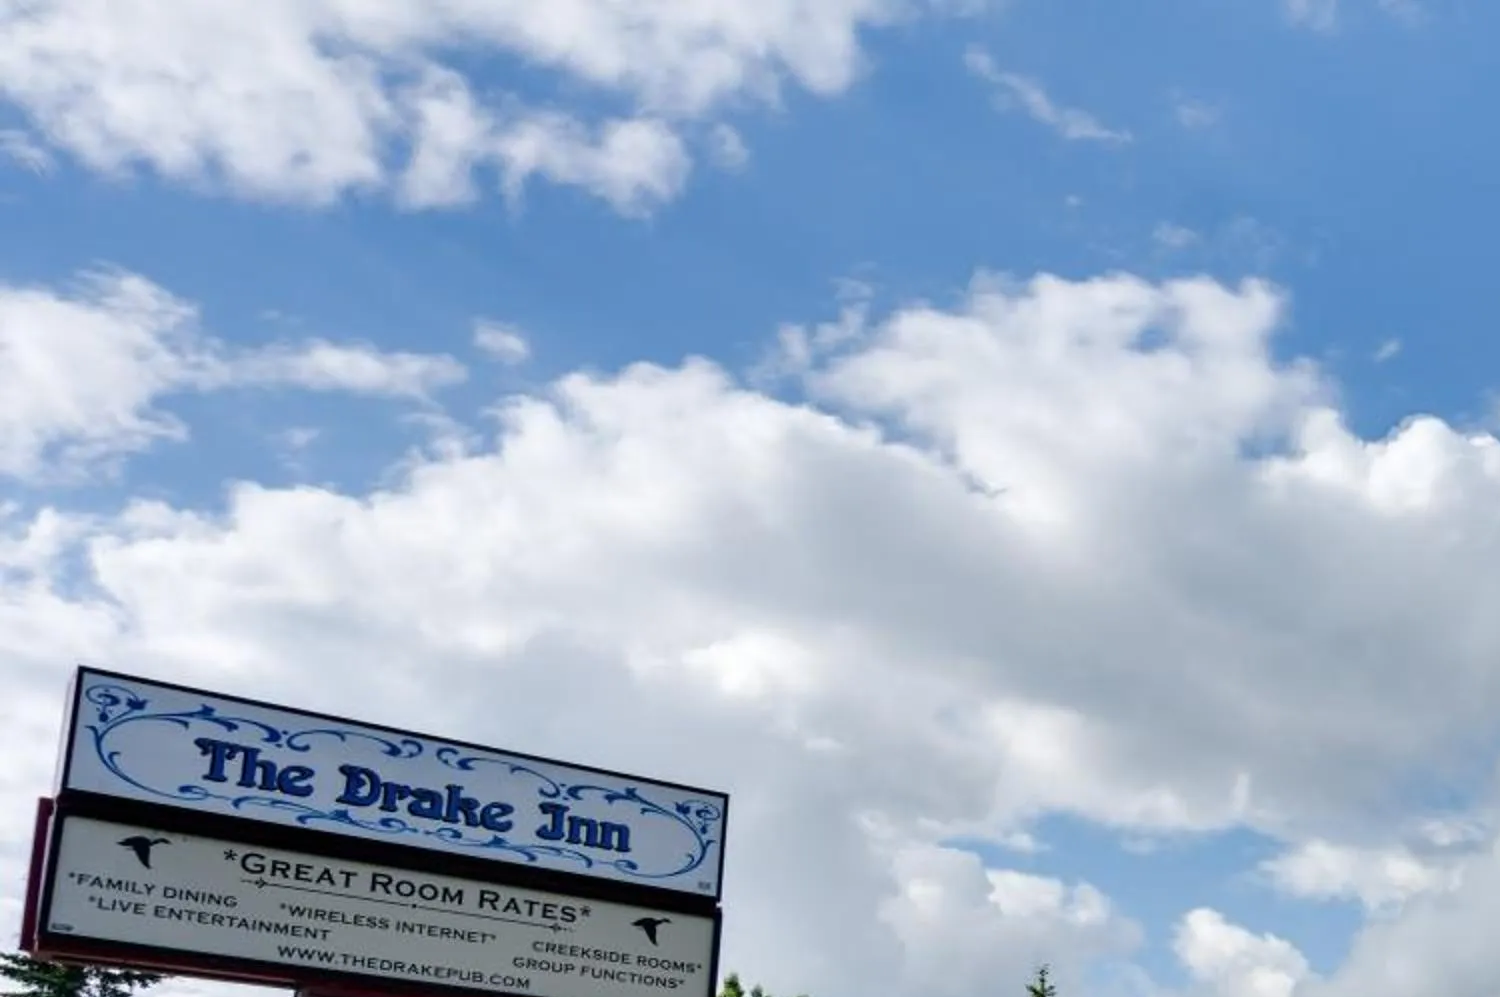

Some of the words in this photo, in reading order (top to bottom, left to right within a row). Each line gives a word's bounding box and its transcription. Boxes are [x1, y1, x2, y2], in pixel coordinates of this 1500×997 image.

[194, 737, 315, 797] The
[336, 764, 515, 833] Drake
[536, 803, 632, 853] Inn
[163, 886, 238, 908] DINING
[370, 873, 464, 905] ROOM
[154, 905, 332, 941] ENTERTAINMENT
[277, 945, 531, 989] WWW.THEDRAKEPUB.COM
[512, 956, 575, 975] GROUP
[532, 940, 631, 965] CREEKSIDE
